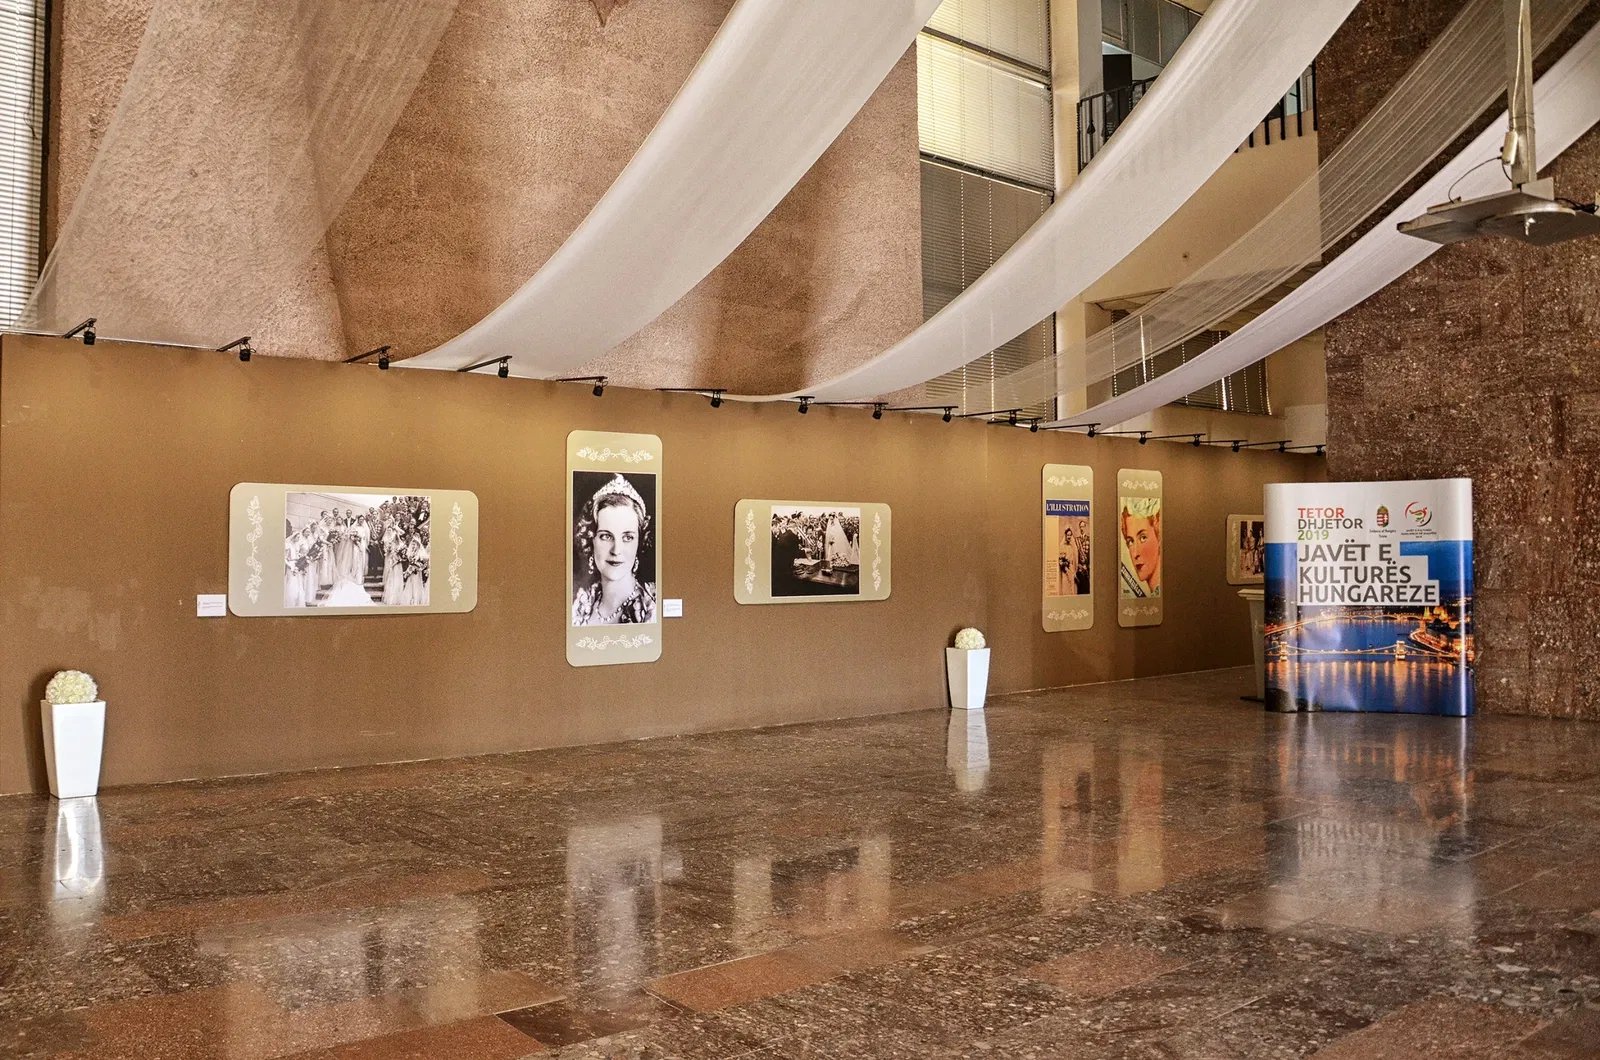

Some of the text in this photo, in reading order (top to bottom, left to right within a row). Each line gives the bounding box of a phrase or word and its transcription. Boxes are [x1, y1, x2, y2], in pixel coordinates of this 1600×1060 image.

[1046, 502, 1089, 512] L'ILLUSTRATION
[1297, 507, 1345, 519] TETOR
[1297, 518, 1363, 530] DHJETOR
[1297, 529, 1329, 541] 2019
[1299, 539, 1392, 562] JAVËT E
[1299, 561, 1412, 584] KULTURËS
[1299, 584, 1437, 603] HUNGAREZE
